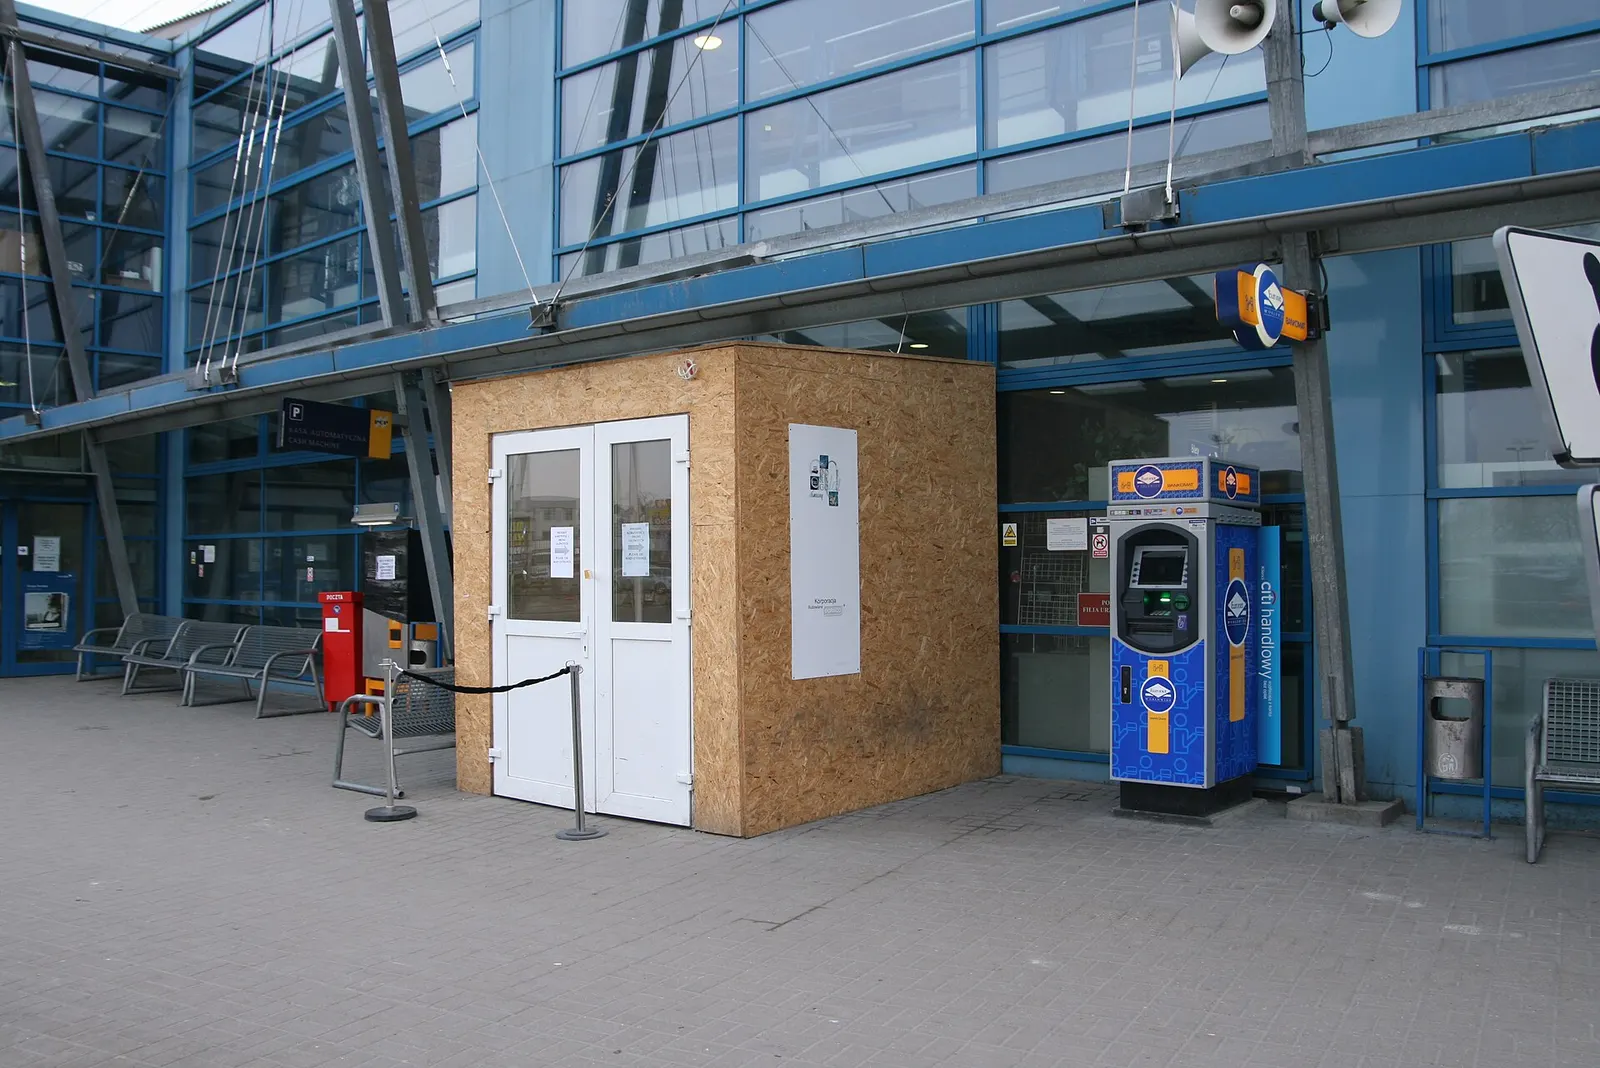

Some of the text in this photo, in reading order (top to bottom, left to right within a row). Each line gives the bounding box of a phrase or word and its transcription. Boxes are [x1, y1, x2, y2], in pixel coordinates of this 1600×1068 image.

[288, 436, 340, 450] CASH MACHINE
[311, 429, 367, 443] AUTOMATYCZNA
[814, 598, 837, 606] Korporacja
[1258, 581, 1276, 680] citi handlowy
